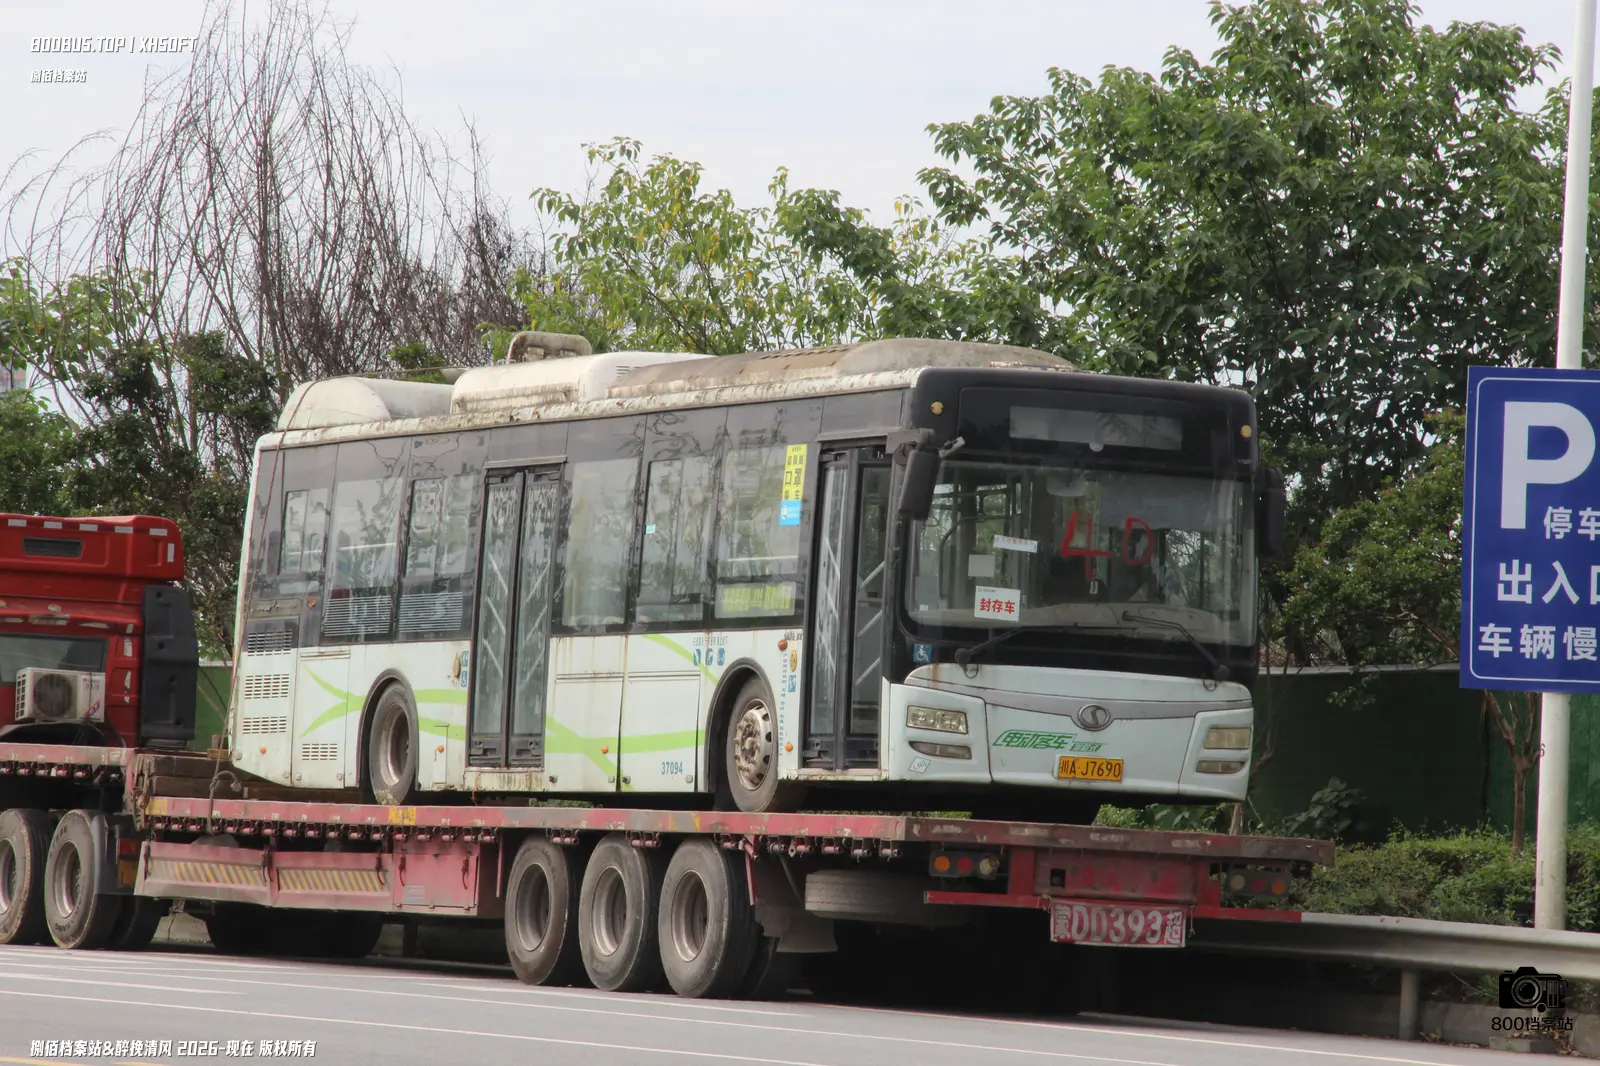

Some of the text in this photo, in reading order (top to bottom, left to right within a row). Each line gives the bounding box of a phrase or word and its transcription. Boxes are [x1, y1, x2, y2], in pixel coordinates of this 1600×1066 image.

[1500, 401, 1596, 529] P
[1543, 506, 1600, 541] 停车
[1062, 511, 1154, 580] 40
[1497, 559, 1600, 605] 出入
[979, 597, 1015, 614] 封存车
[1478, 623, 1598, 661] 车辆慢
[1002, 732, 1073, 750] 电动客车
[661, 761, 683, 775] 37094
